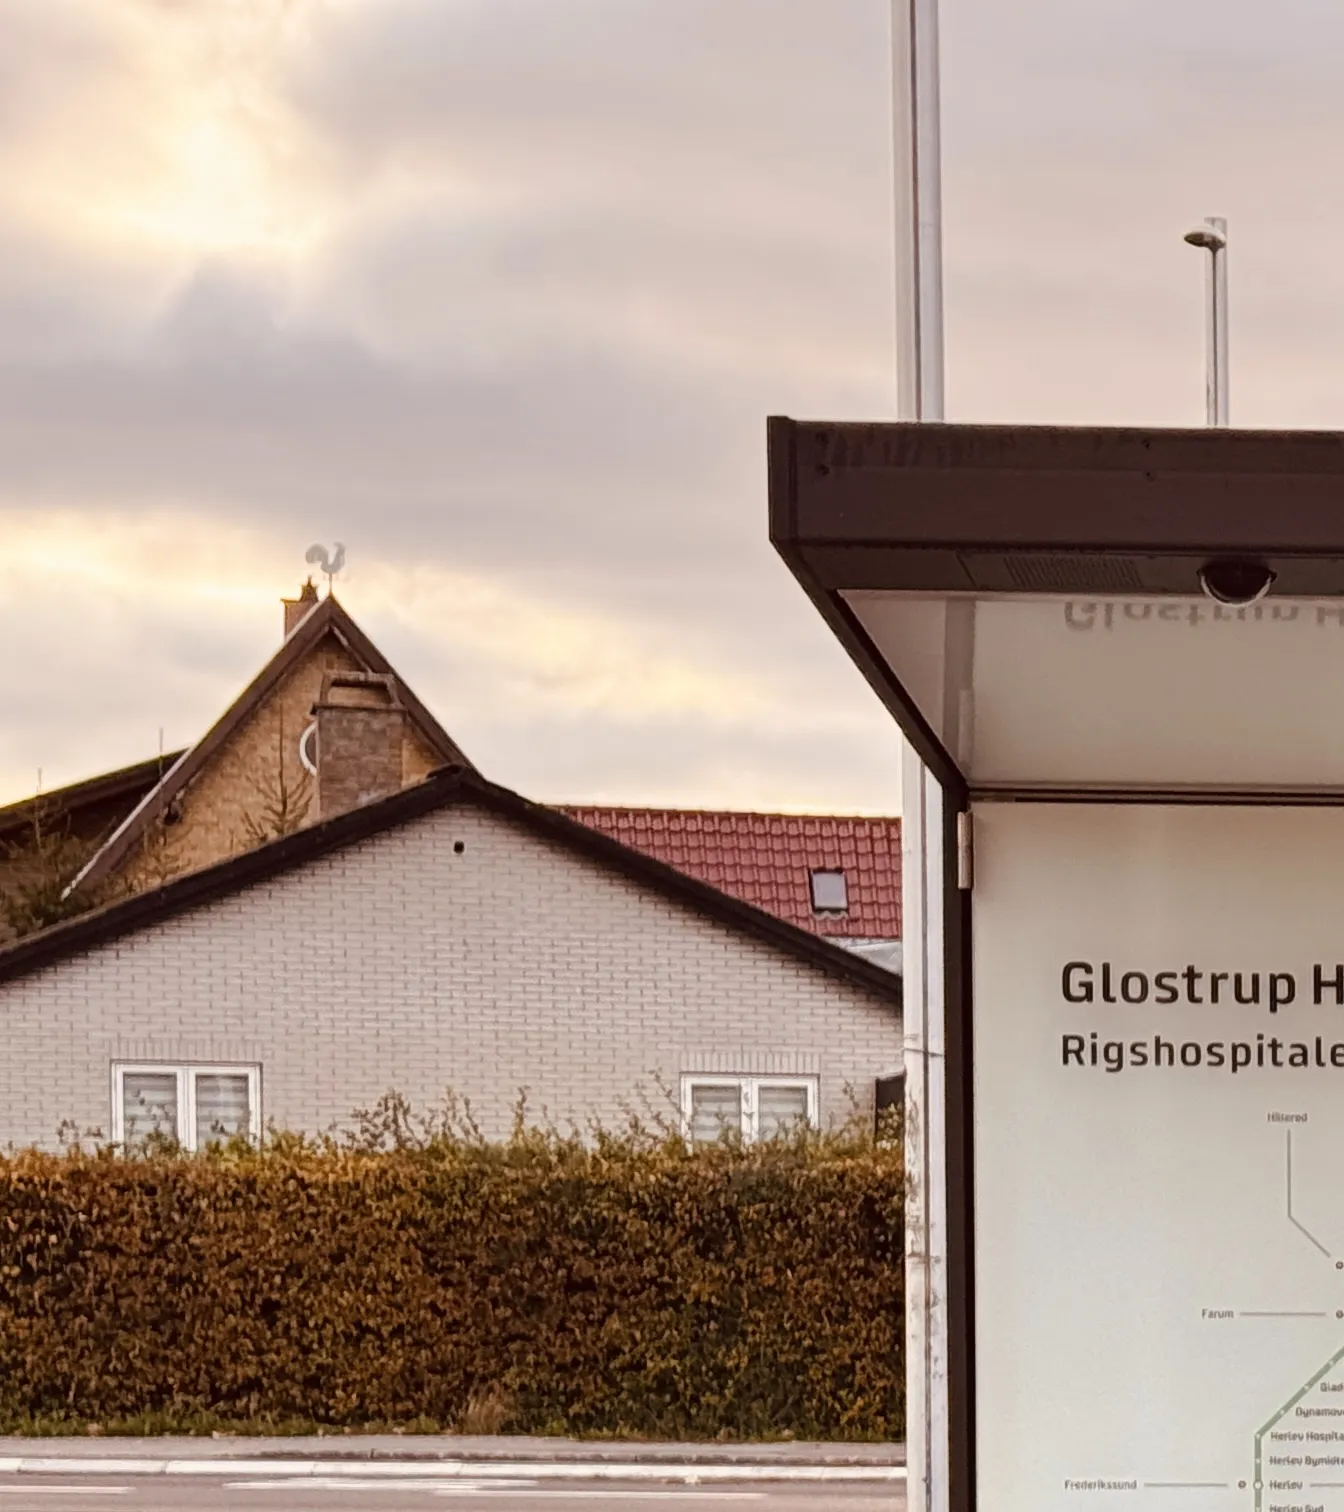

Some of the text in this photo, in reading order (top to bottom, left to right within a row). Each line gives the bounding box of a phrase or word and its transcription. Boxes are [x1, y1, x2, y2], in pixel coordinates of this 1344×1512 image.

[1062, 962, 1295, 1014] Glostrup
[1202, 1308, 1234, 1319] Farum
[1271, 1432, 1304, 1441] Herlev
[1269, 1455, 1303, 1466] Herlev
[1065, 1480, 1137, 1490] Frederikssund
[1269, 1480, 1303, 1490] Herlev
